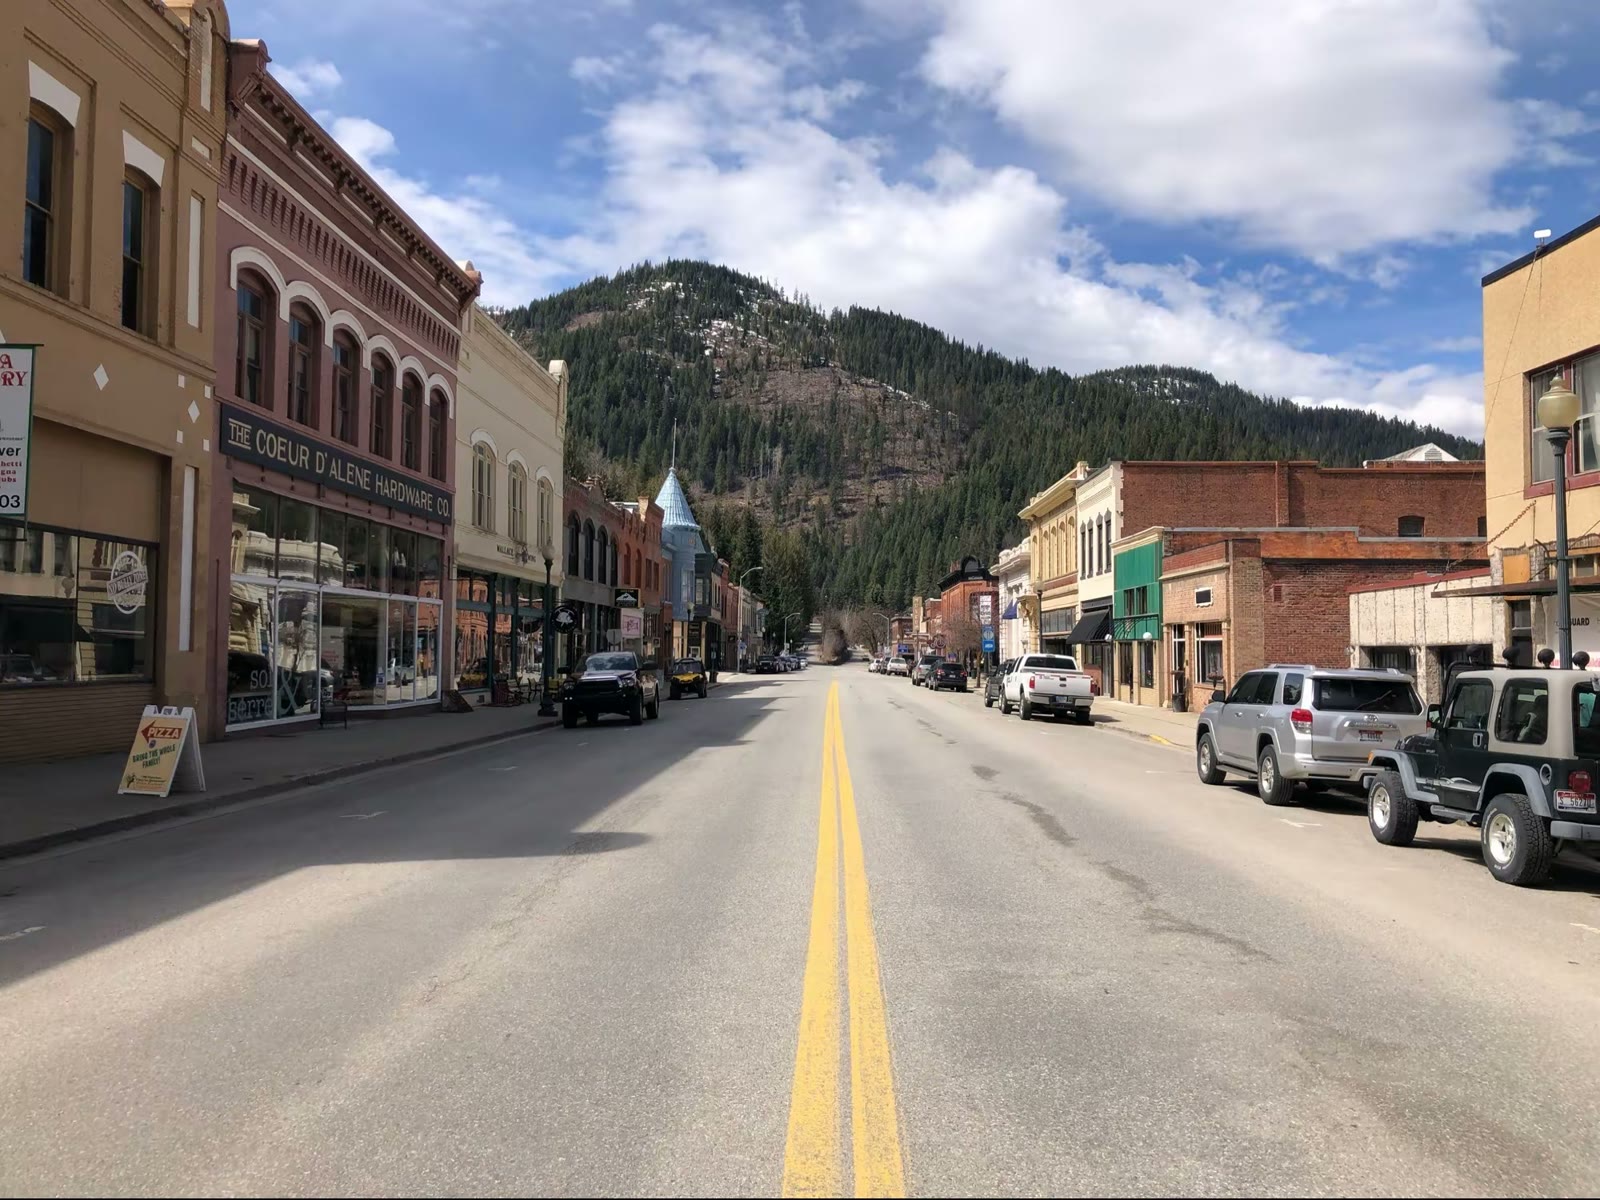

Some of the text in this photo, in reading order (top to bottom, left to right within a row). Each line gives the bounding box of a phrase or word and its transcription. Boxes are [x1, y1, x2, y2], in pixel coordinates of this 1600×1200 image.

[229, 422, 251, 445] THE
[256, 429, 310, 470] COEUR
[375, 474, 433, 512] HARDWARE
[437, 497, 450, 517] CO.
[0, 494, 20, 508] 03
[1571, 617, 1590, 626] UARD
[147, 727, 179, 738] PIZZA
[159, 744, 175, 755] WHOLE
